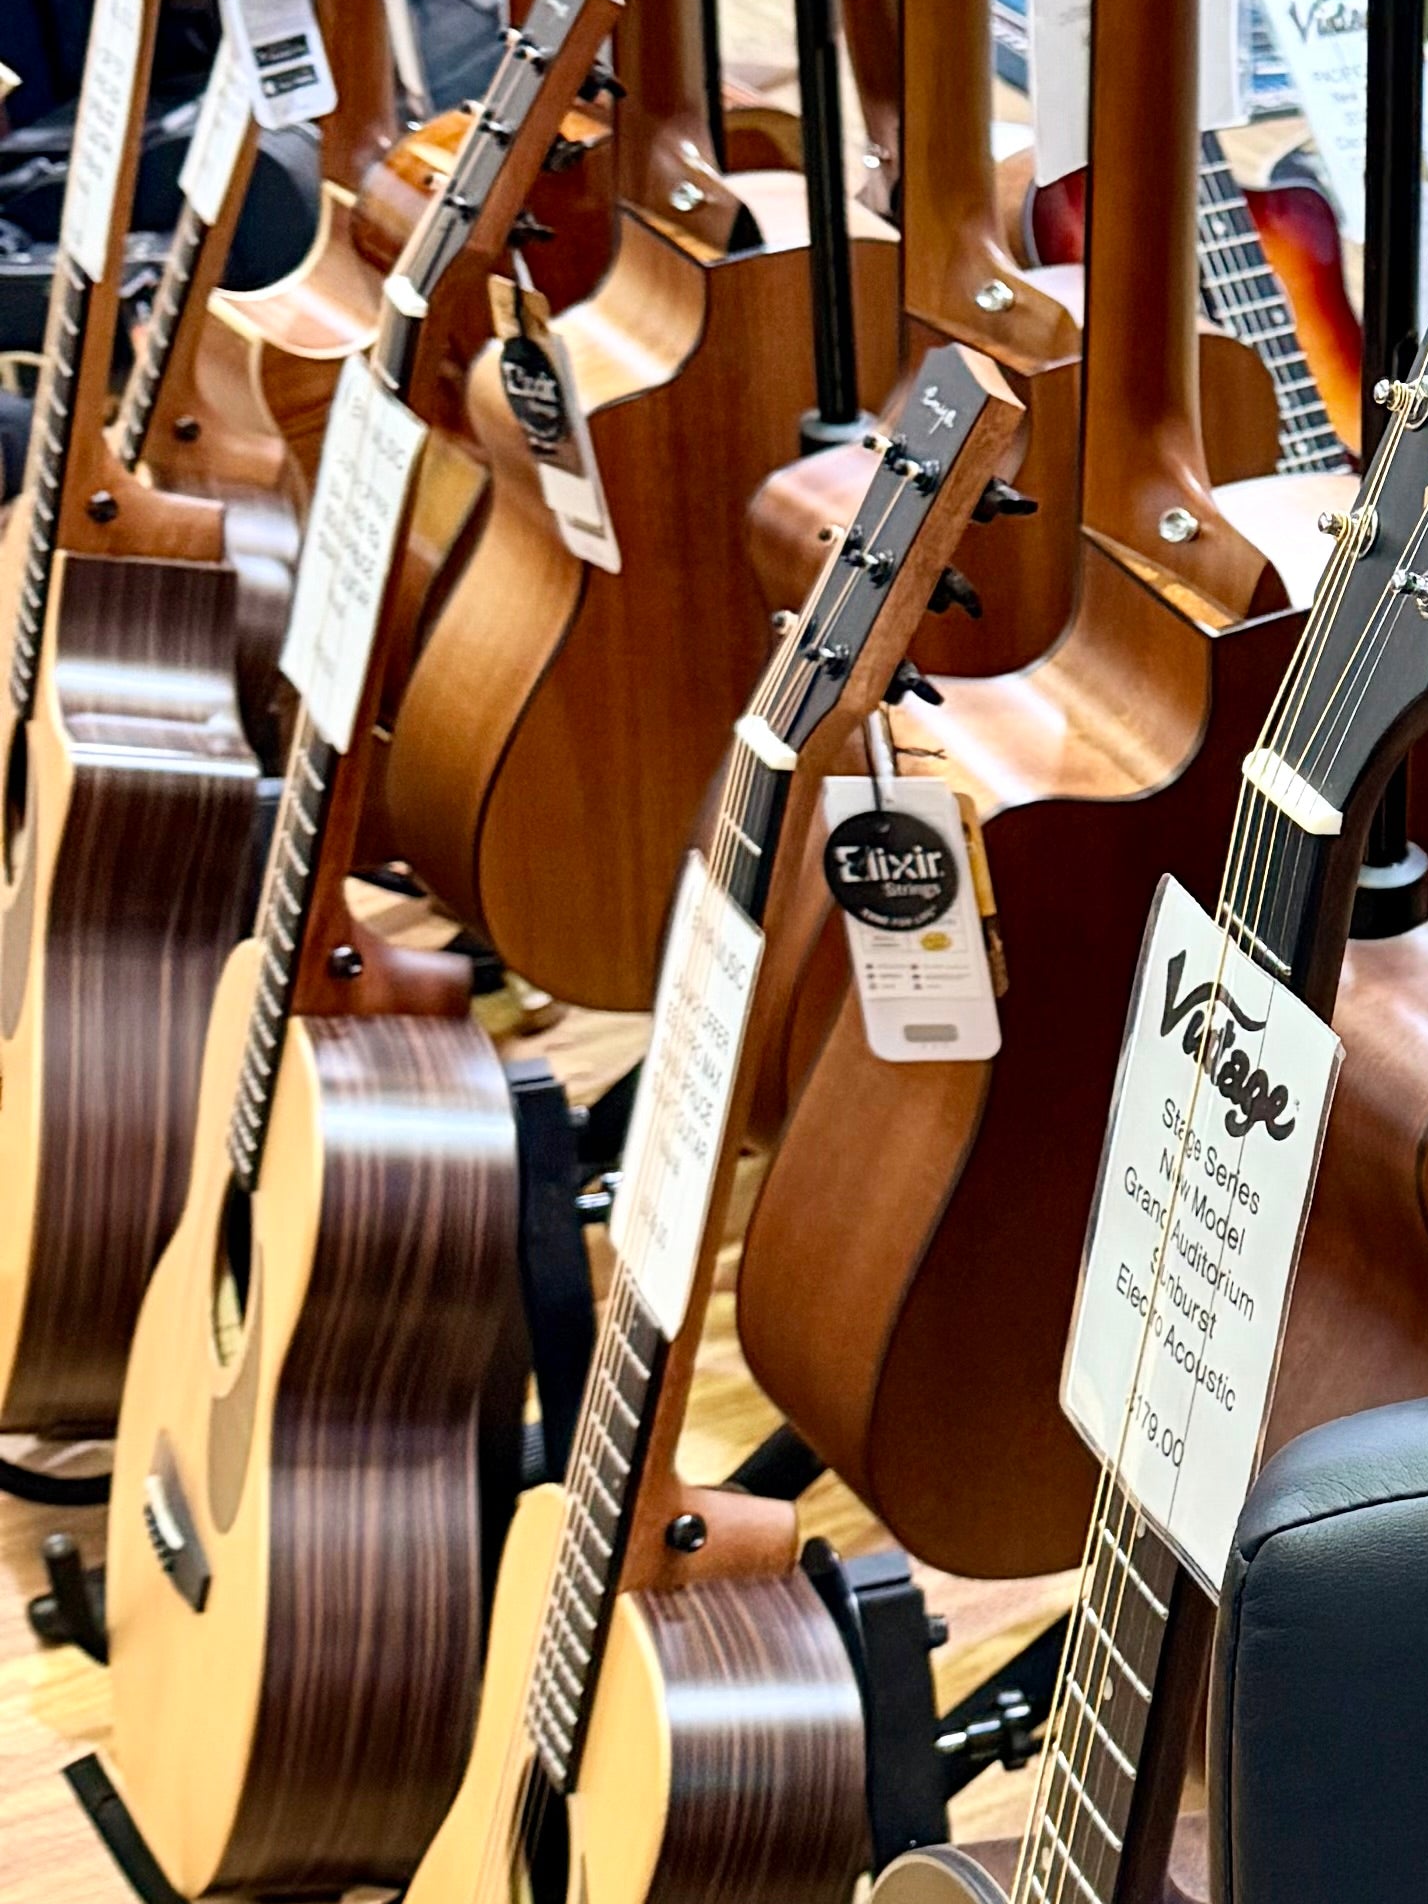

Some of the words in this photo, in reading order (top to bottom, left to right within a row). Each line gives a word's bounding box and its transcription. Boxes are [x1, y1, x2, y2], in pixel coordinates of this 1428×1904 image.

[832, 845, 945, 884] Elixir
[883, 882, 942, 900] Strings
[1160, 949, 1296, 1142] Vintage
[1161, 1098, 1203, 1163] Stage
[1203, 1145, 1261, 1216] Series
[1190, 1185, 1246, 1256] Model
[1169, 1218, 1256, 1323] Auditorium
[1115, 1261, 1165, 1338] Elecro
[1162, 1323, 1237, 1412] Acoustic
[1125, 1394, 1186, 1469] 179.00
